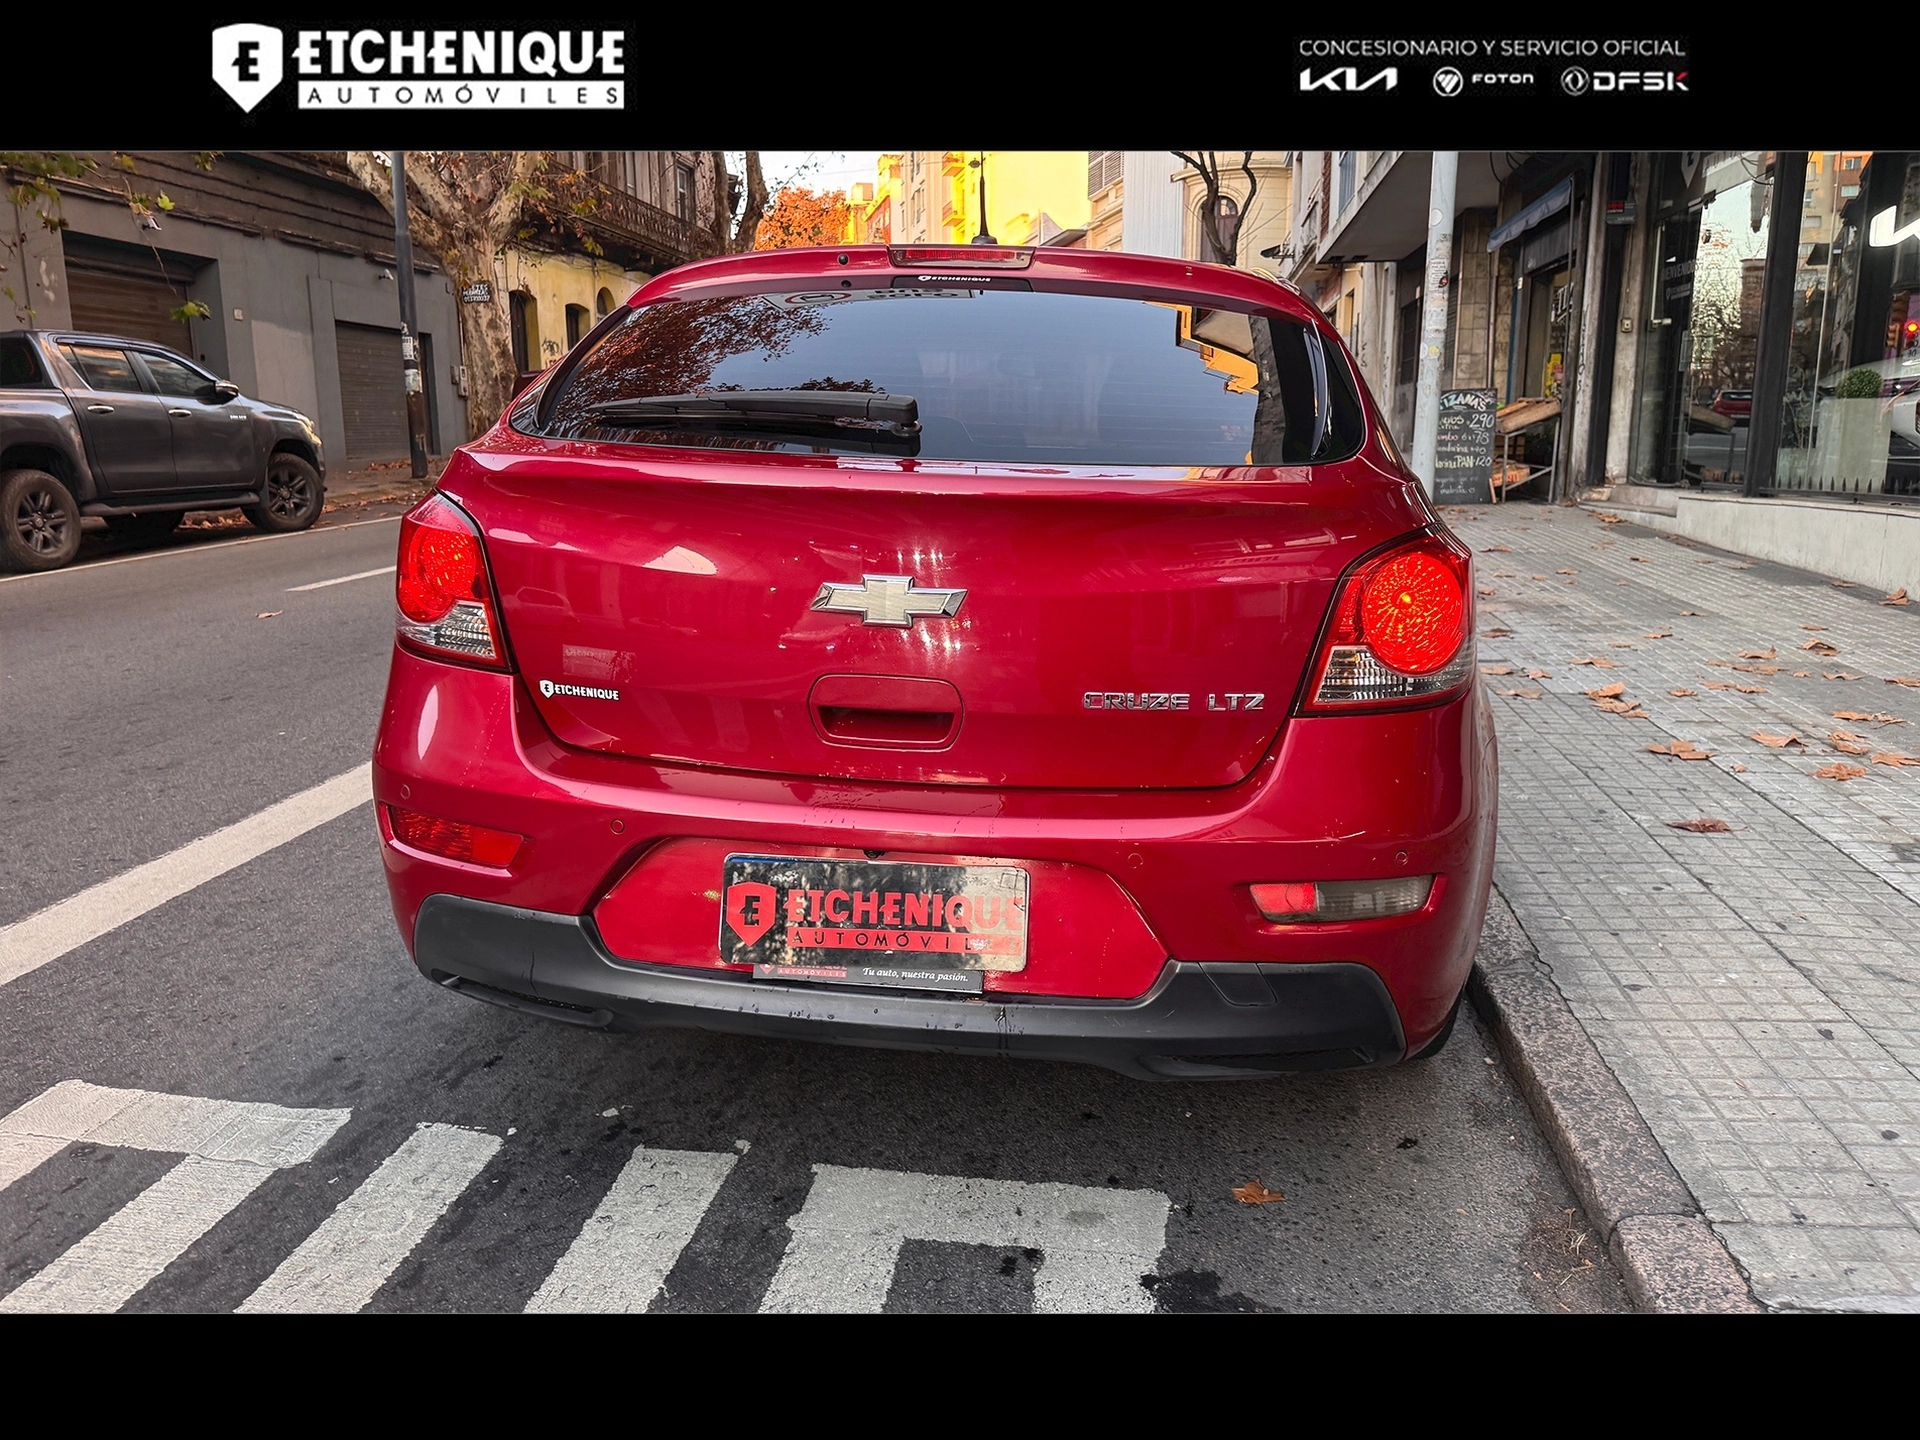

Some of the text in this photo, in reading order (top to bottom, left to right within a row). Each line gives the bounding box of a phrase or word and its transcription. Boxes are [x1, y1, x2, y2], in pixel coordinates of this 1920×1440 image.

[1440, 392, 1486, 411] IZANA'S
[554, 684, 619, 700] ETCHENIQUE
[1083, 692, 1265, 711] CRUZE LTZ
[783, 889, 1023, 932] ETCHENIQUE
[862, 966, 969, 982] Tu auto, nuestra pasión.
